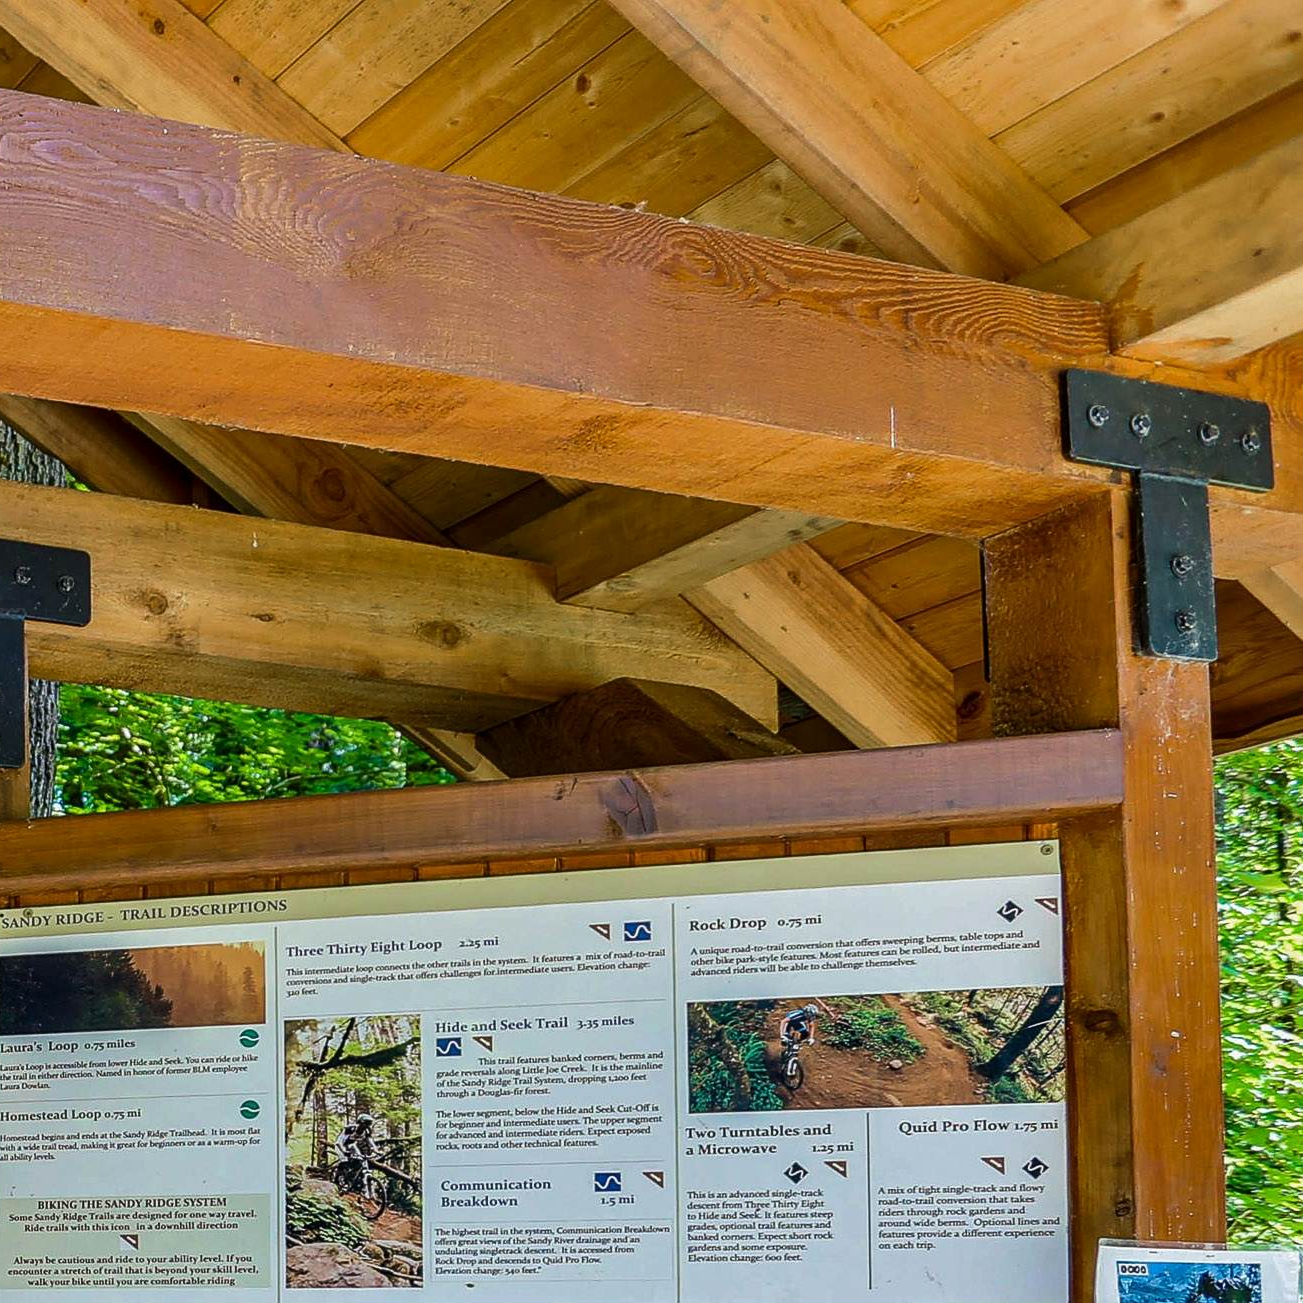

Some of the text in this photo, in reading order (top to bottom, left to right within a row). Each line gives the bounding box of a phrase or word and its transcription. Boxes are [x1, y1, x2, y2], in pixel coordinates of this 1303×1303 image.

[0, 914, 55, 931] SANDY
[53, 911, 105, 929] RIDGE
[119, 907, 167, 921] TRAIL
[170, 899, 288, 921] DESCRIPTIONS
[689, 914, 822, 931] Rock Drop 0.75 mi
[285, 936, 499, 957] Three Thirty Eight Loop 2.25 mi
[434, 1015, 635, 1034] Hide and Seek Trail 3.35 miles
[0, 1107, 141, 1123] Homestead Loop 0.75 mi
[898, 1119, 1059, 1136] Quid Pro Flow 1.75 mi
[440, 1178, 551, 1191] Communication
[37, 1197, 226, 1211] BIKING THE SANDY RIDGE SYSTEM
[441, 1195, 518, 1207] Breakdown
[600, 1194, 634, 1207] 1.5 mi
